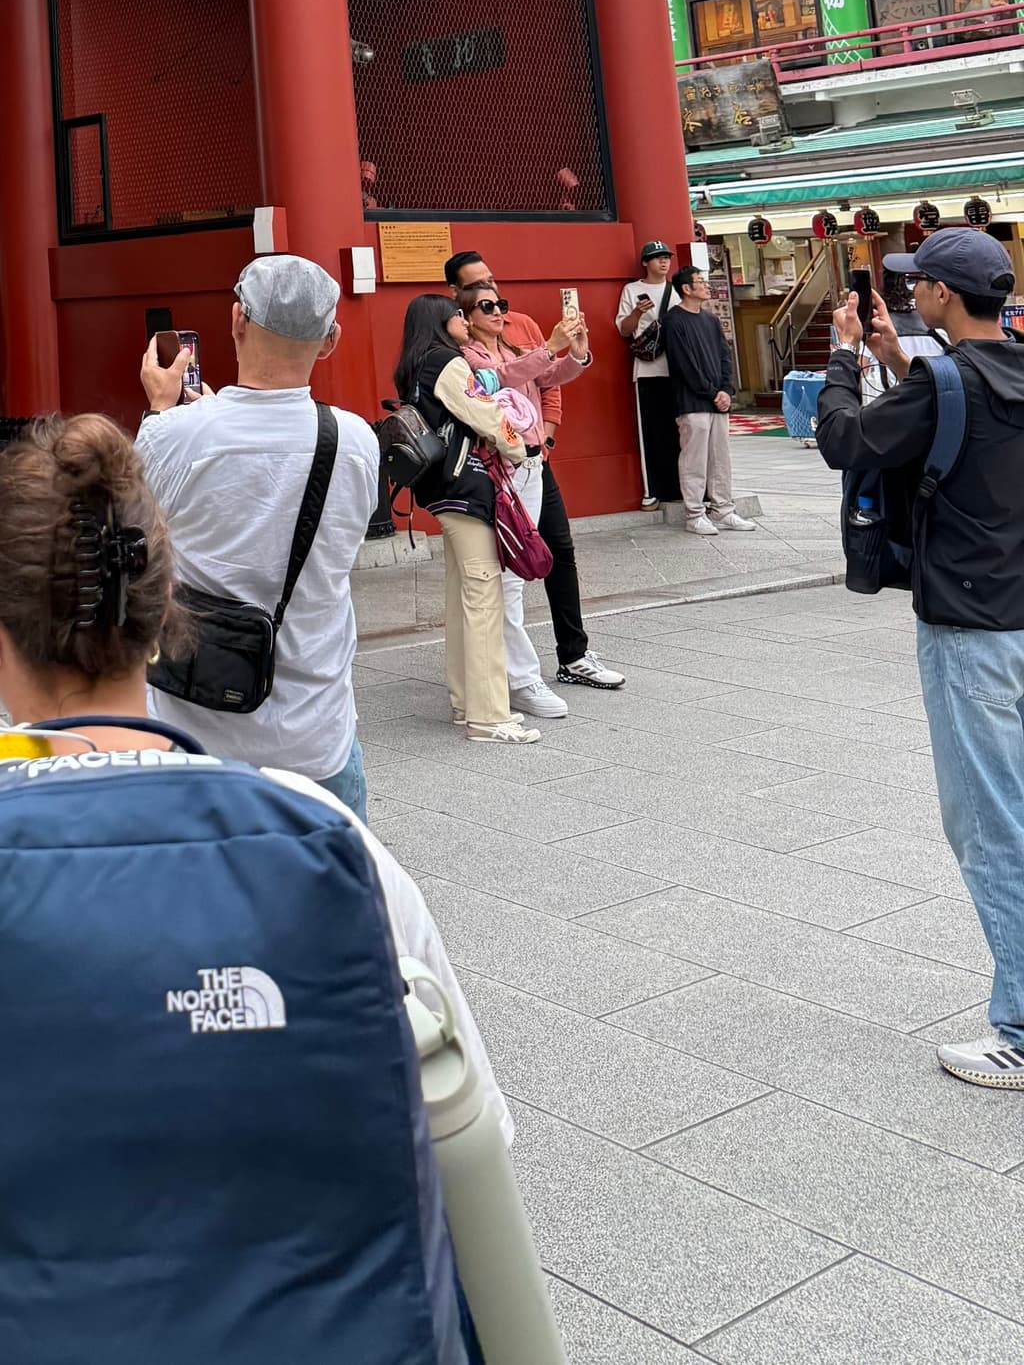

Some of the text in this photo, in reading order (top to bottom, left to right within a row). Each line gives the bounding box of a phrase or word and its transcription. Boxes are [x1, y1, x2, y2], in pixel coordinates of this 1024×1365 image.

[28, 750, 138, 778] FACE
[197, 967, 243, 990] THE
[166, 987, 243, 1012] NORTH
[191, 1007, 247, 1033] FACE
